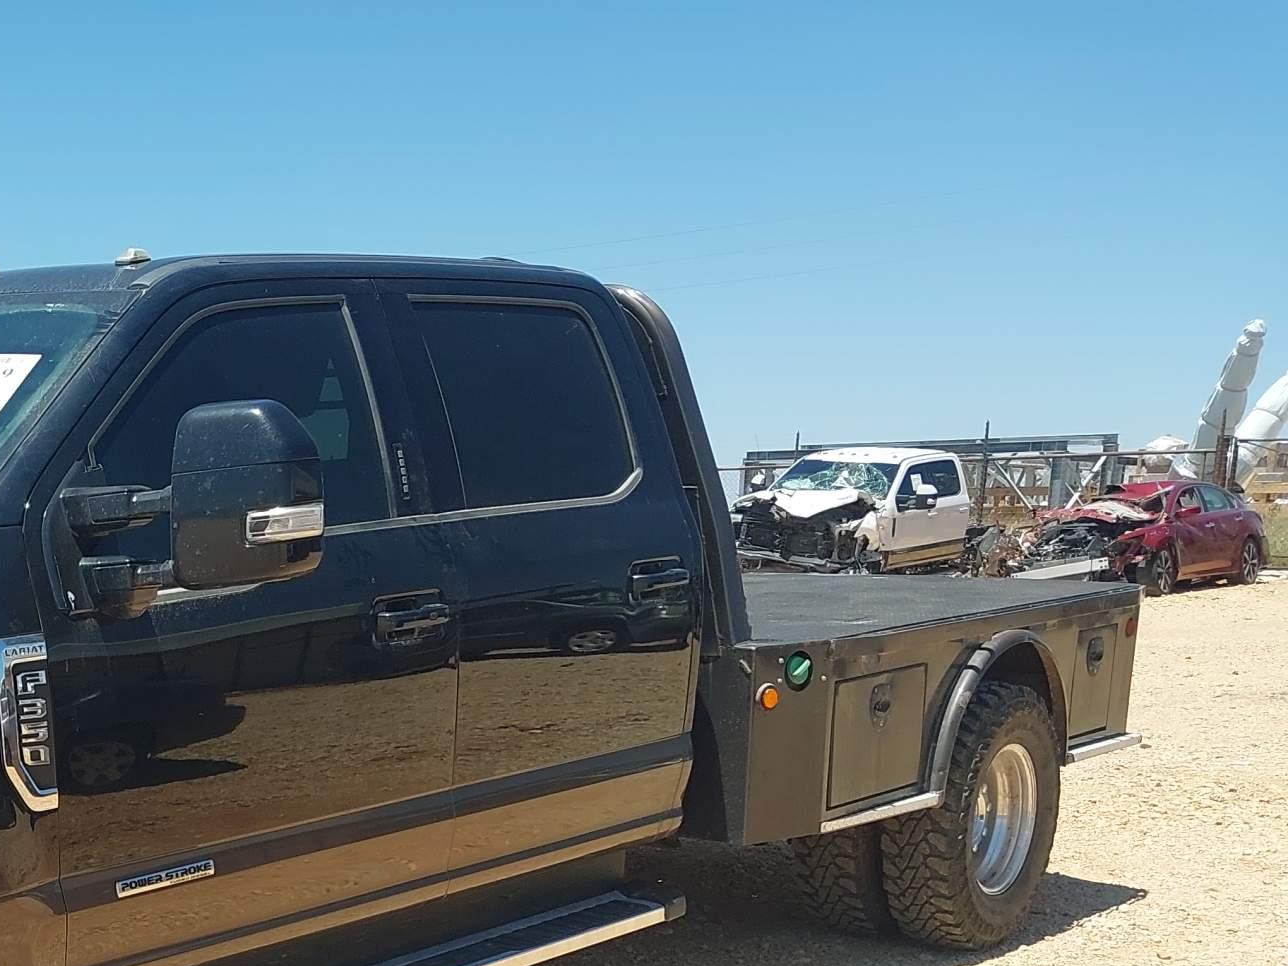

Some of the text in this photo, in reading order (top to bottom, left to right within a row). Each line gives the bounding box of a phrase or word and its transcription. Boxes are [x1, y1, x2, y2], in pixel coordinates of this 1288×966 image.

[5, 644, 45, 657] LARIAT
[15, 669, 51, 766] F350
[120, 873, 164, 892] POWER
[165, 861, 212, 881] STROKE
